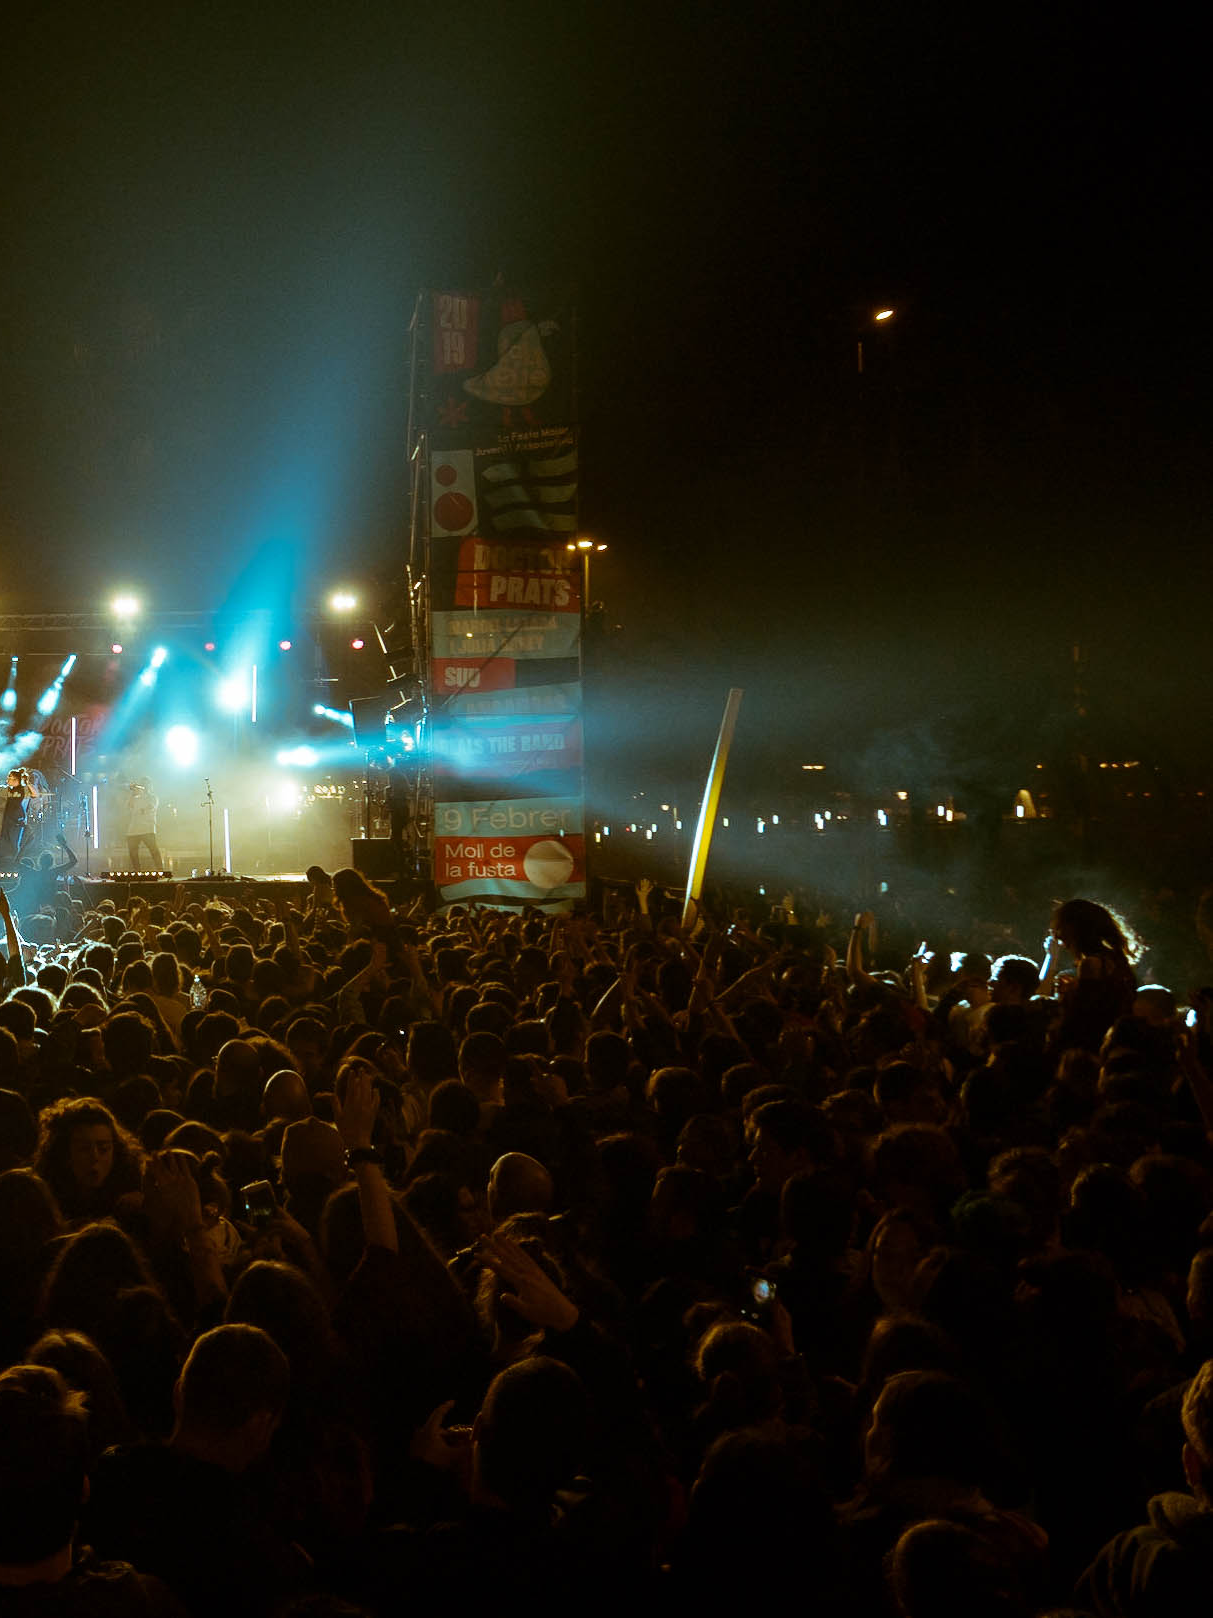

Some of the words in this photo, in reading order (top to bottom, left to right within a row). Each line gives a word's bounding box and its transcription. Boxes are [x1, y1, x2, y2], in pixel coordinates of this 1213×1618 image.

[490, 575, 571, 607] PRATS
[487, 735, 516, 753] THE
[521, 733, 565, 752] BAND
[443, 808, 462, 832] 9
[472, 807, 570, 832] Febrer
[445, 843, 484, 859] Moll
[489, 842, 516, 858] de
[445, 862, 462, 878] la
[468, 861, 517, 878] fusta
